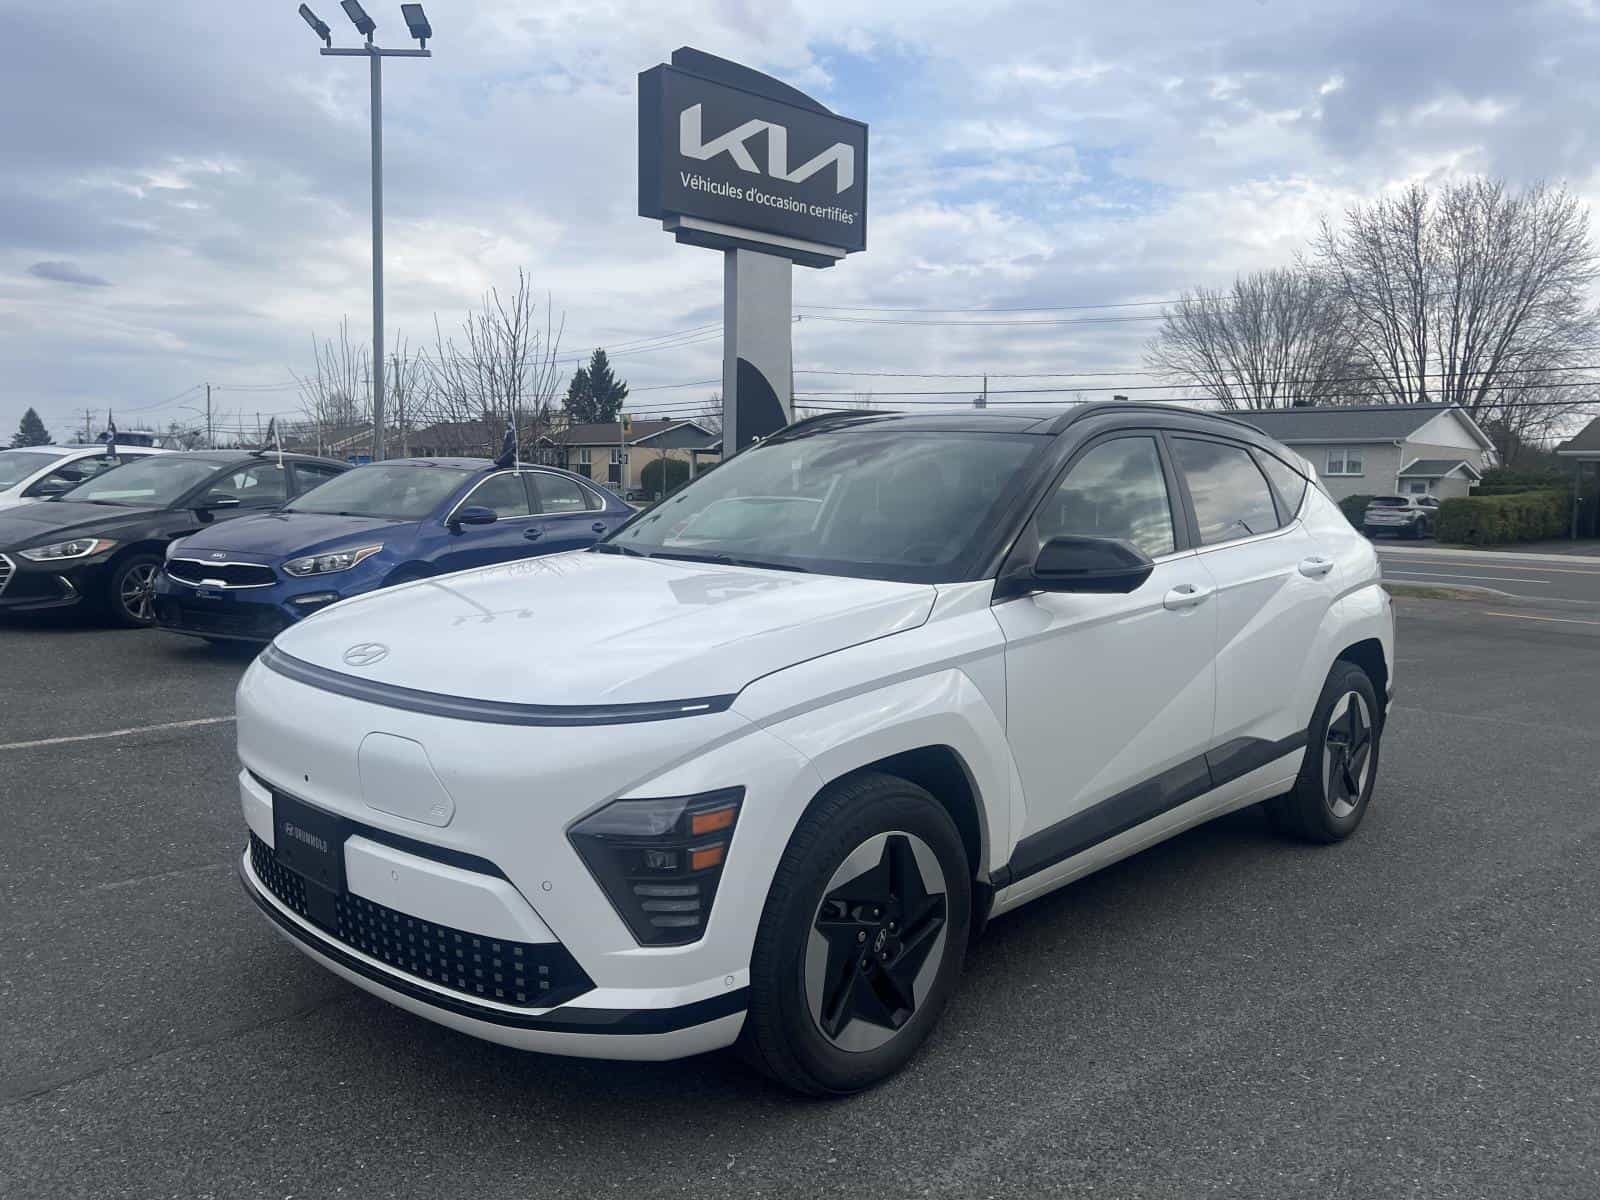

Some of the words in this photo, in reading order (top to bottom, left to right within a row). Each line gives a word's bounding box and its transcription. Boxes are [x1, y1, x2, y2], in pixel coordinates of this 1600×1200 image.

[680, 171, 743, 199] Véhicules
[746, 187, 807, 214] d'occasion
[809, 205, 854, 224] certifiés
